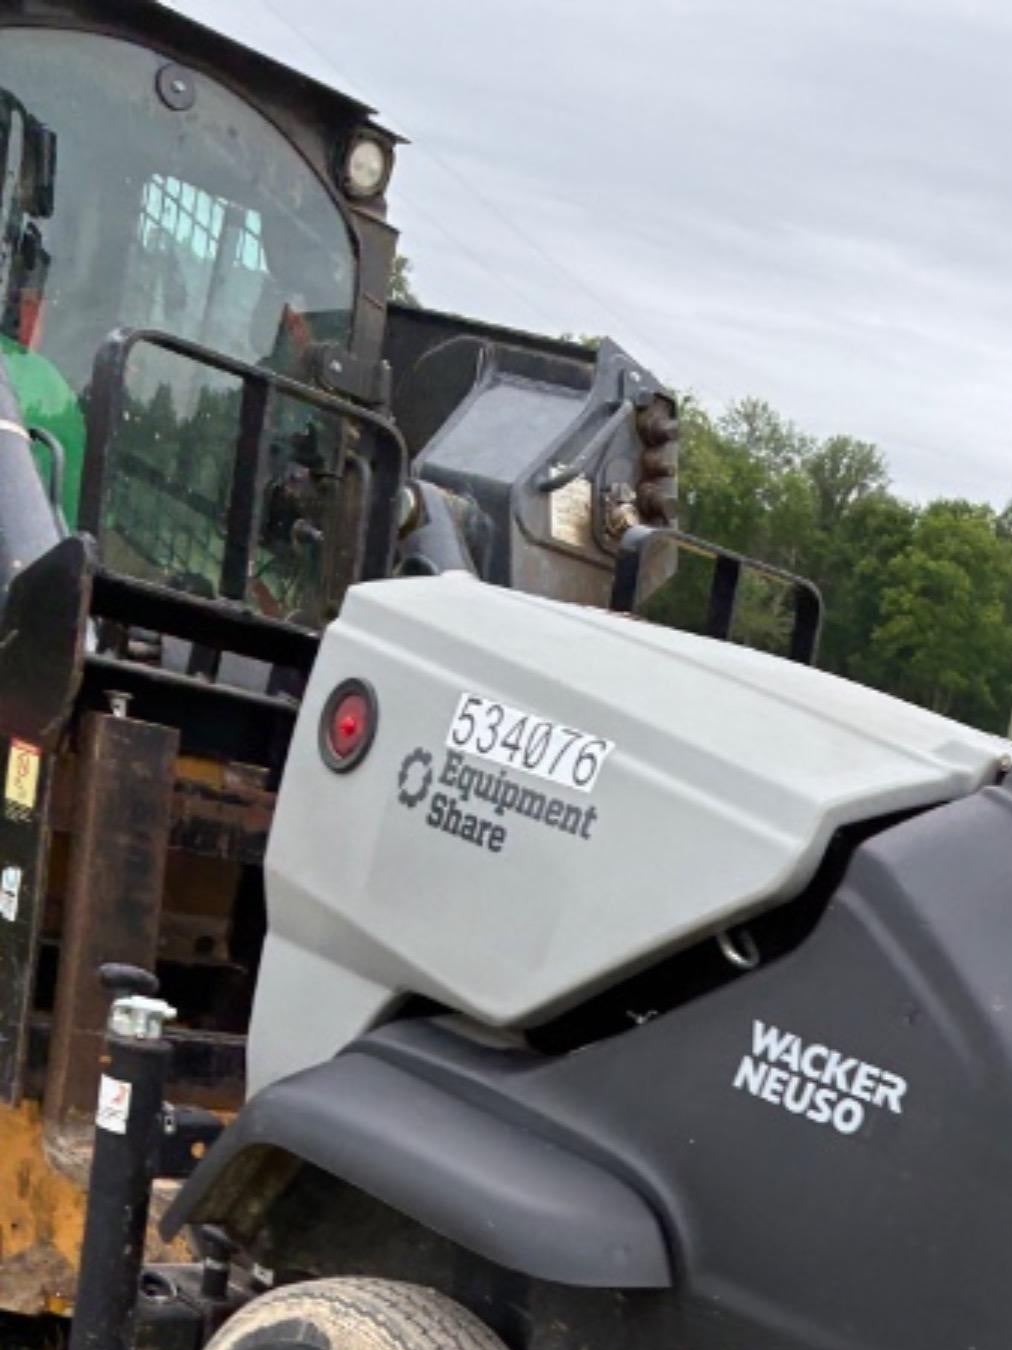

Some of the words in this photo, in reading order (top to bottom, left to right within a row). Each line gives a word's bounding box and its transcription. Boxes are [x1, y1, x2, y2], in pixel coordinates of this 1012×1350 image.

[452, 697, 608, 787] 534076
[426, 791, 508, 853] Share
[438, 749, 598, 841] Equipment
[732, 1054, 865, 1135] NEUSO
[752, 1018, 908, 1114] WACKER
